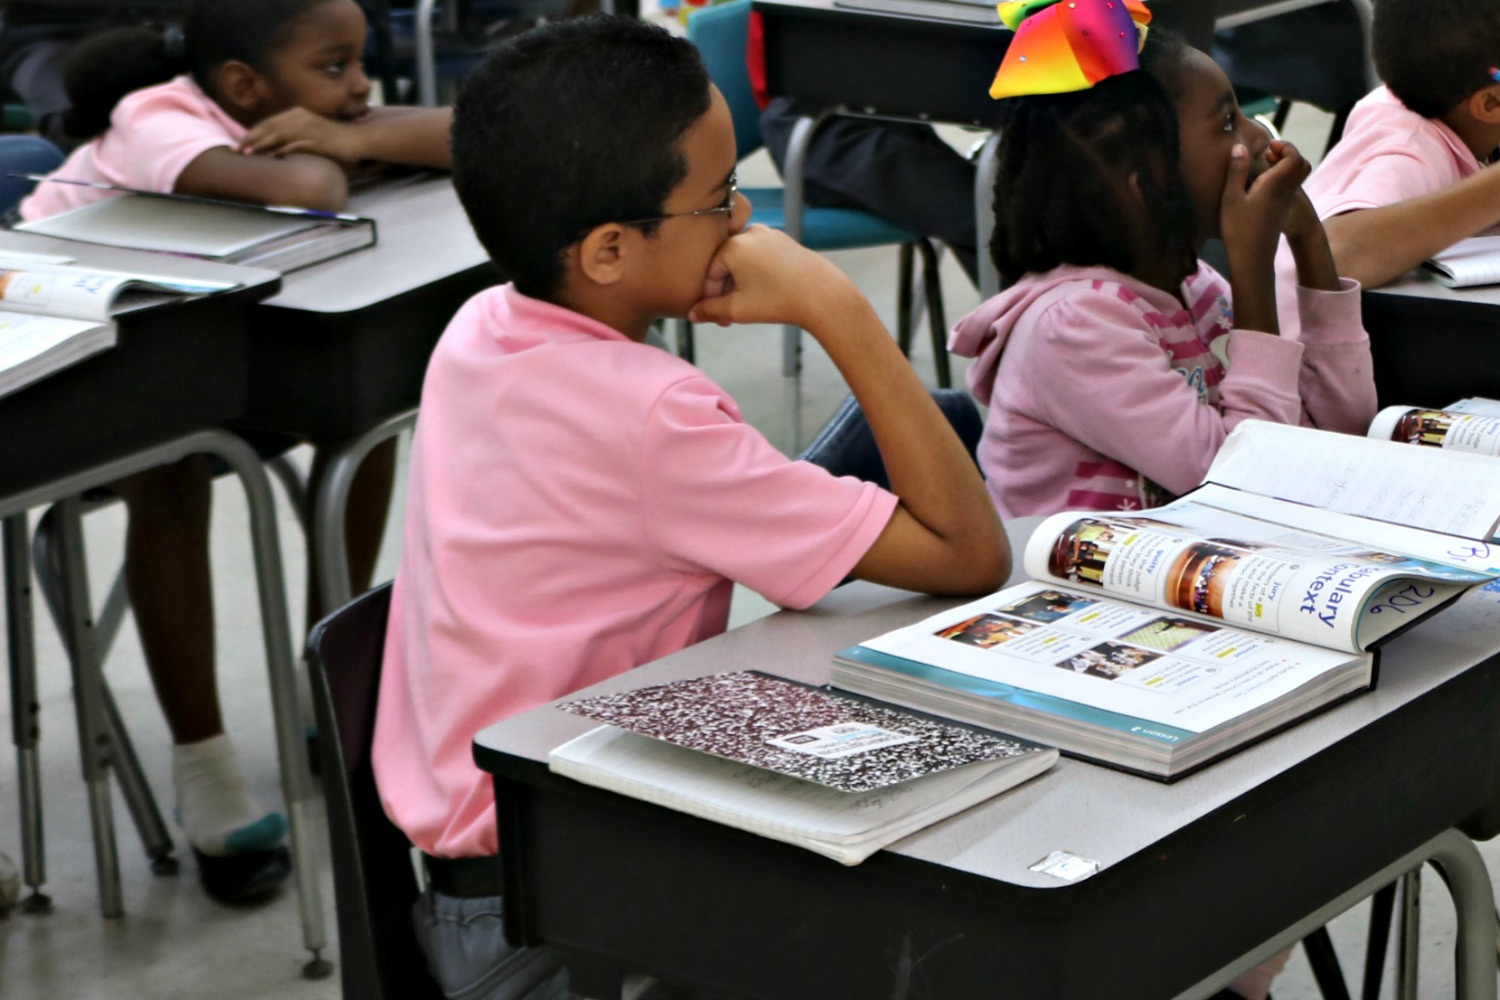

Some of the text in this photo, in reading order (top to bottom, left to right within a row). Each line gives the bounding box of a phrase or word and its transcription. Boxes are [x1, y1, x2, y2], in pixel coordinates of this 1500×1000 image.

[1146, 549, 1165, 575] guilty
[1126, 568, 1134, 588] think
[1268, 581, 1282, 602] jury
[1247, 610, 1255, 623] the
[1255, 603, 1263, 619] jury
